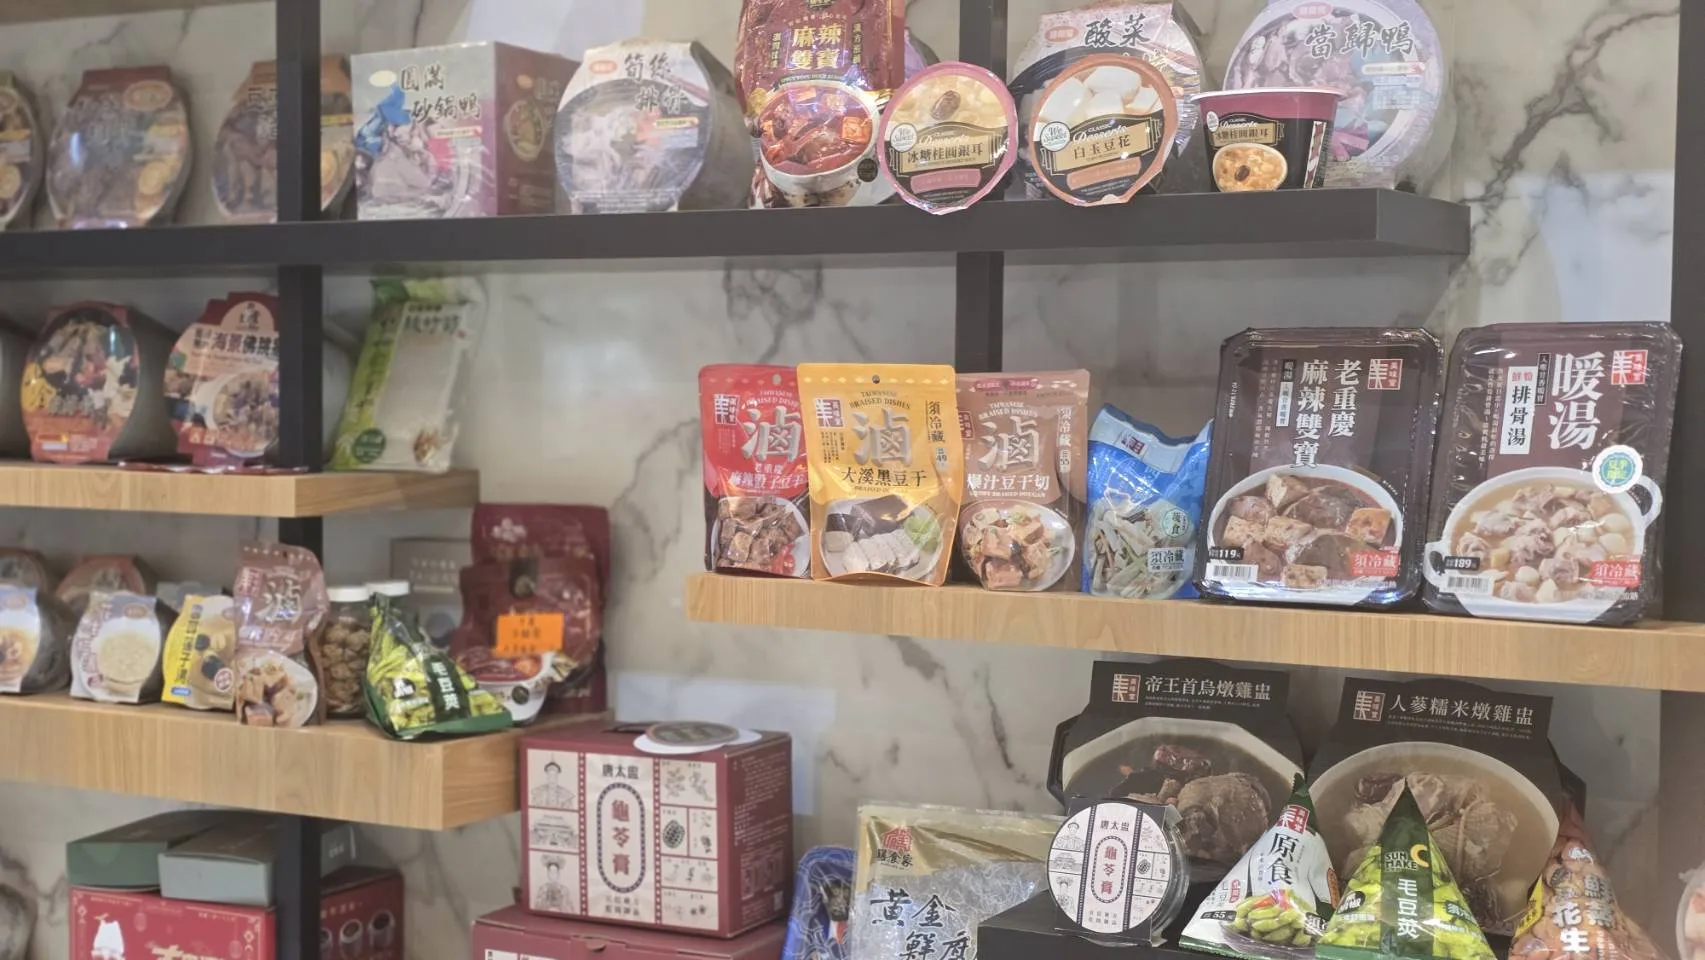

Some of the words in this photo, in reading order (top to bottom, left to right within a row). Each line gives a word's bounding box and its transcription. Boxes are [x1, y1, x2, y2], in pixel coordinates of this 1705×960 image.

[791, 23, 842, 47] 麻辣
[1084, 13, 1150, 47] 酸菜
[1305, 20, 1414, 58] 當歸鴨
[624, 52, 671, 82] 筍絲
[411, 93, 481, 123] 砂鍋鴨
[1073, 134, 1131, 161] 白玉豆花
[1290, 359, 1330, 469] 麻辣雙寶
[1328, 359, 1362, 437] 老重慶
[1507, 385, 1532, 446] 排骨湯
[1548, 352, 1606, 450] 暖湯
[741, 405, 802, 463] 滷
[852, 407, 912, 467] 滷
[928, 401, 946, 443] 須冷藏
[978, 415, 1040, 473] 滷
[841, 466, 928, 488] 大溪黑豆干
[1355, 553, 1398, 568] 須冷藏
[1453, 559, 1472, 568] 189
[1145, 675, 1271, 701] 帝王首烏燉雞盅
[610, 799, 631, 876] 龜苓膏
[1385, 851, 1408, 860] SUN
[1268, 833, 1299, 885] 原食
[870, 888, 957, 928] 黃金
[1397, 878, 1420, 939] 毛豆莢
